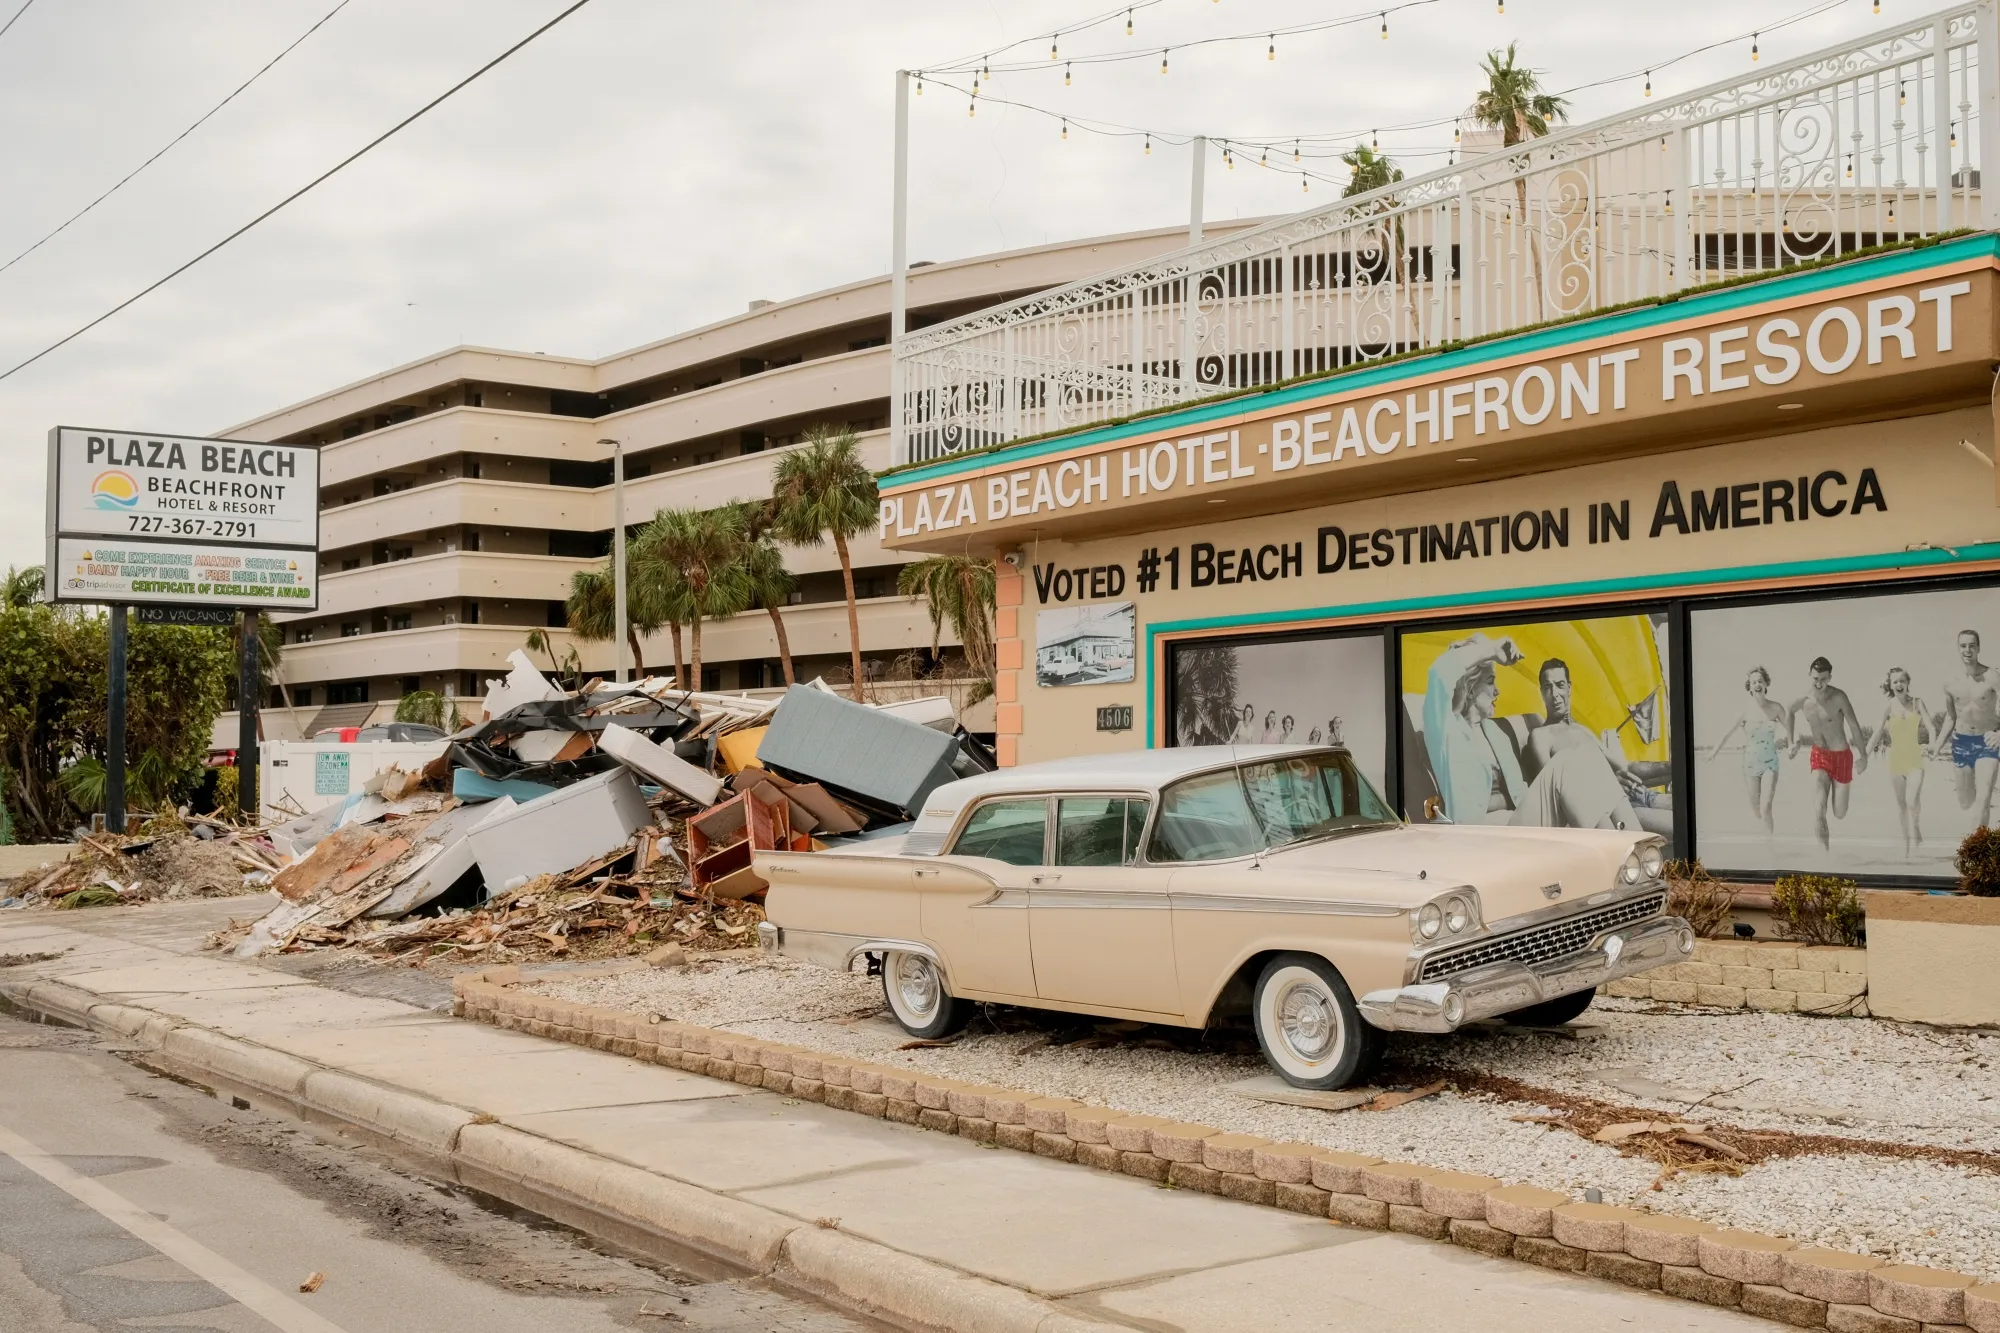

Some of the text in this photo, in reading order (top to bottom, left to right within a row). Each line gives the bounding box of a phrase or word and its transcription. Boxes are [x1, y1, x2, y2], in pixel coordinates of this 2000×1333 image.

[879, 281, 1971, 539] PLAZA BEACH HOTEL BEACHFRONT RESORT
[86, 436, 296, 478] PLAZA BEACH
[148, 477, 286, 500] BEACHFRONT
[157, 497, 276, 515] HOTEL & RESORT
[128, 515, 256, 538] 727-367-2791
[94, 550, 287, 571] COME EXPERIENCE AMAZING SERVICE
[1136, 547, 1180, 593] #1
[86, 580, 126, 589] tripadvisor
[87, 563, 295, 585] DAILY HAPPY HOUR FREE BEER & WINE
[131, 580, 311, 599] CERTIFICATE OF EXCELLENCE AWARD
[141, 608, 235, 623] NO VACANCY
[1098, 708, 1131, 728] 4506
[324, 761, 340, 770] ZONE
